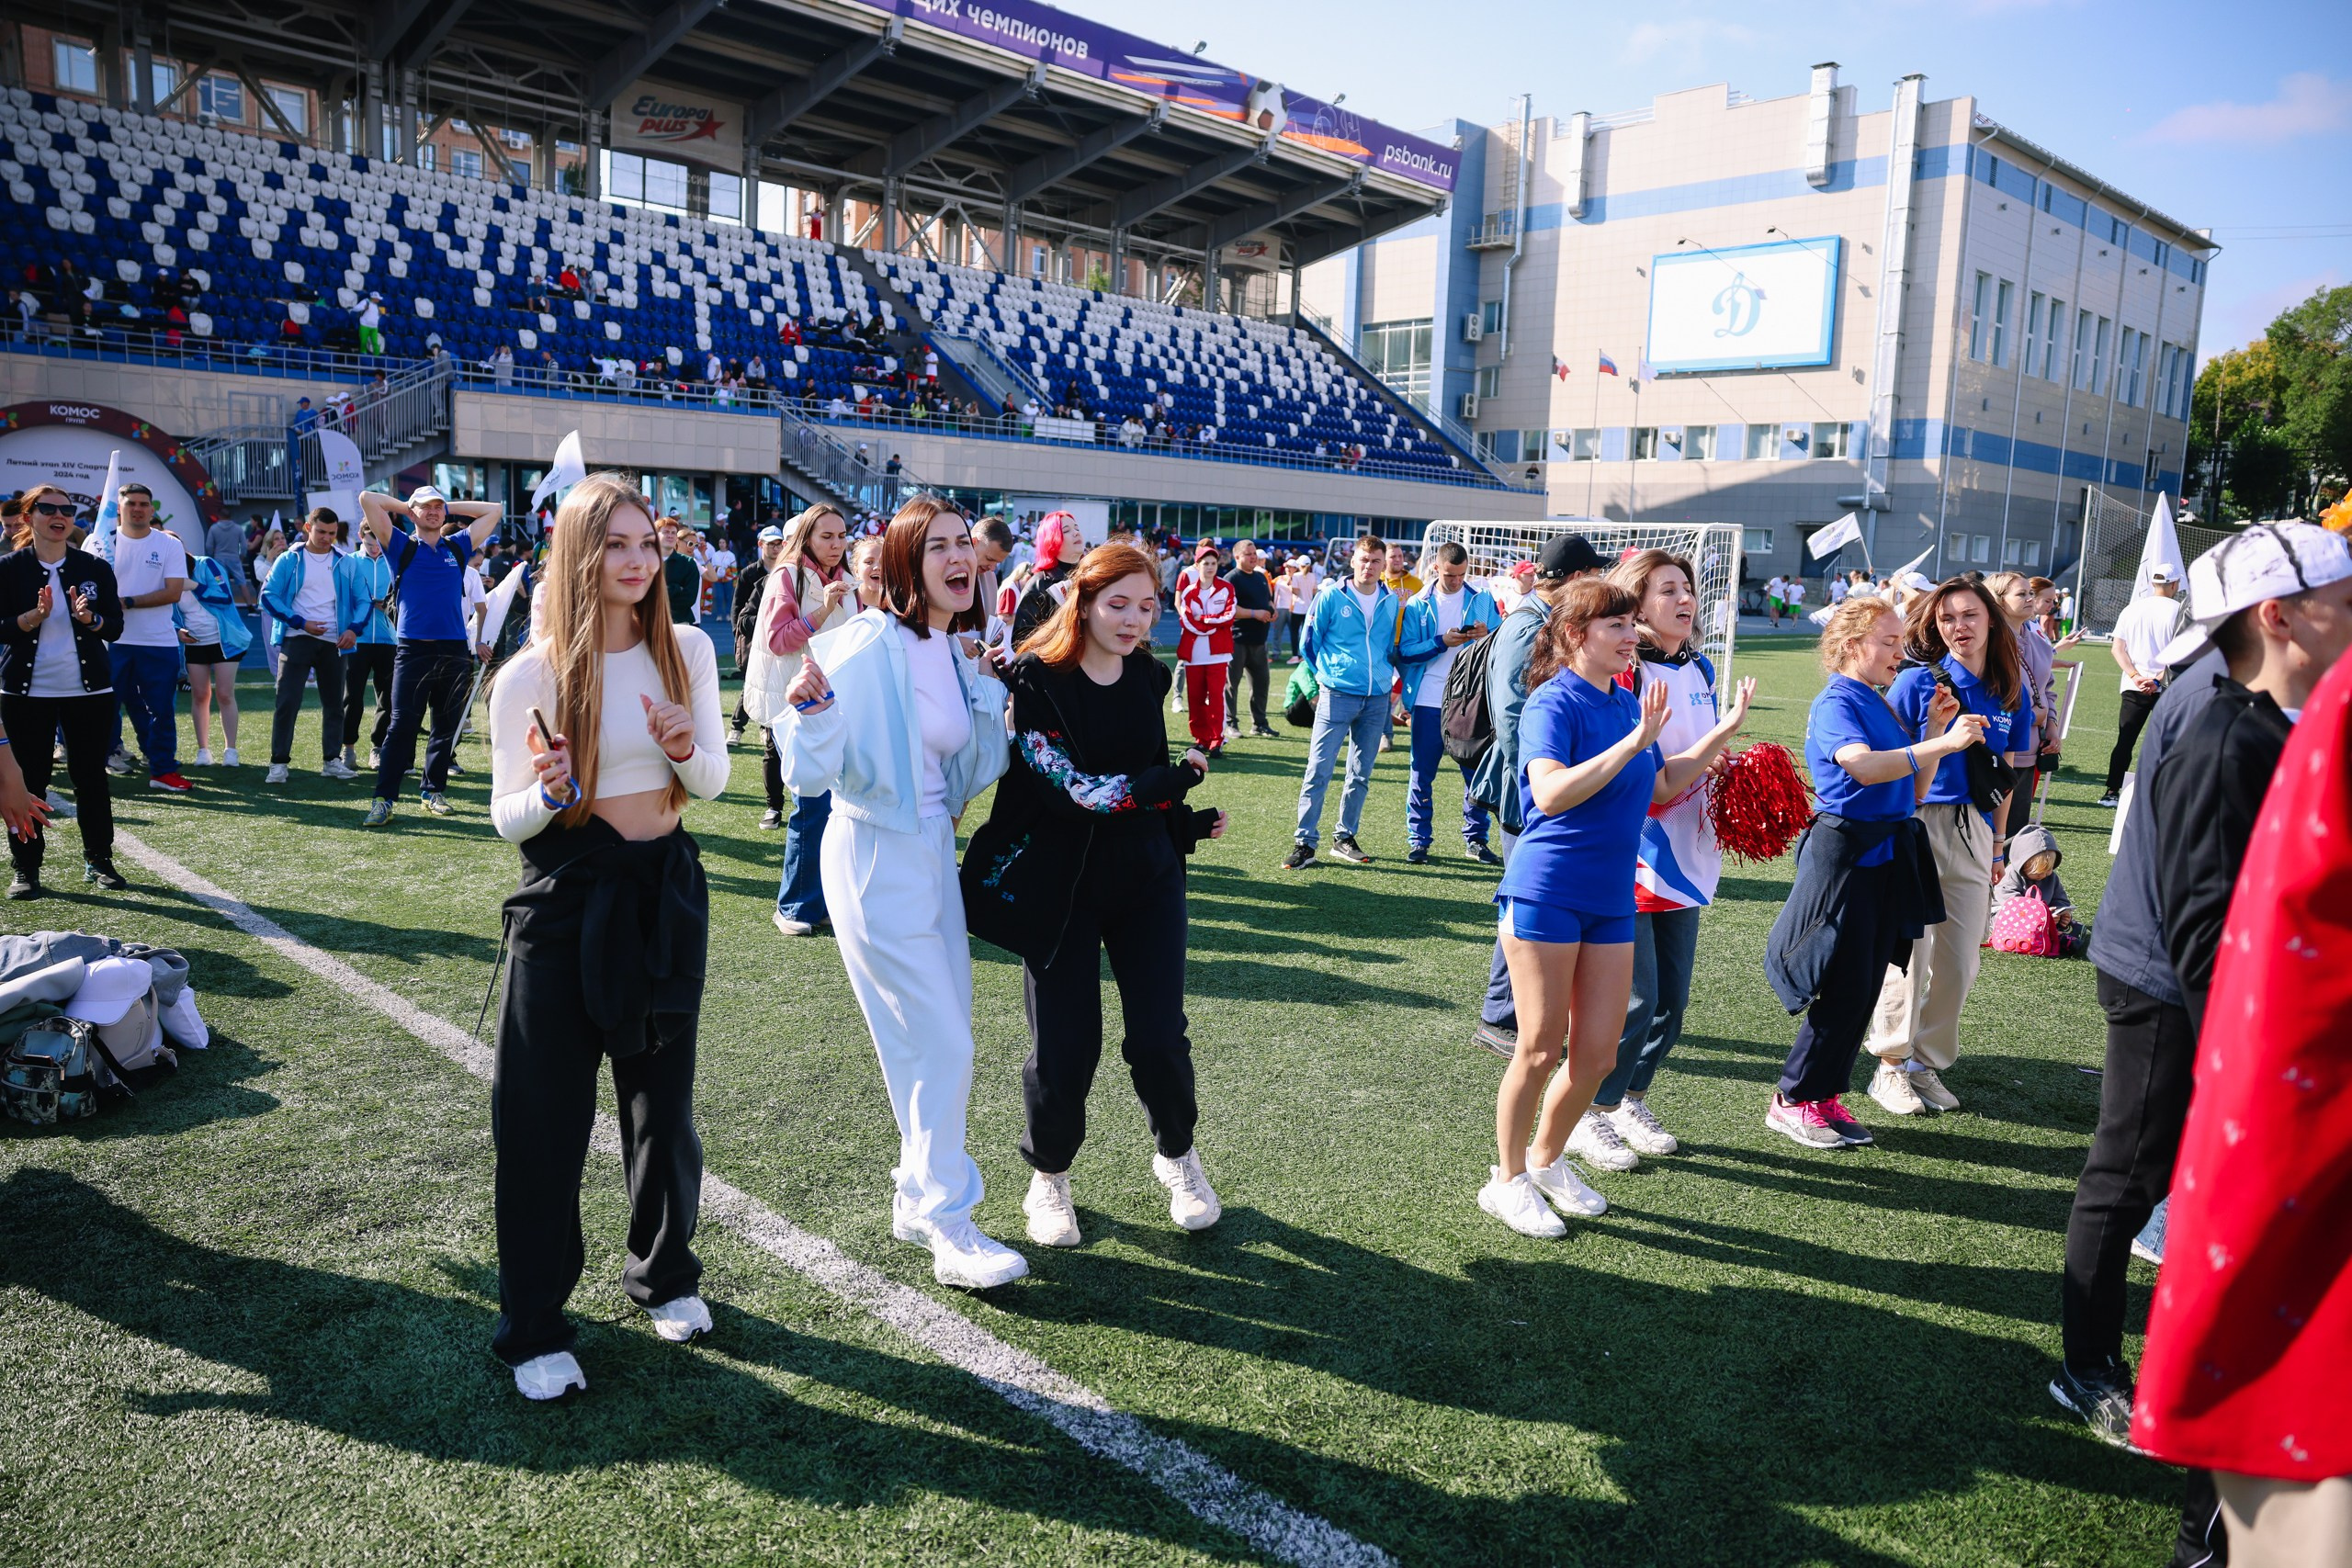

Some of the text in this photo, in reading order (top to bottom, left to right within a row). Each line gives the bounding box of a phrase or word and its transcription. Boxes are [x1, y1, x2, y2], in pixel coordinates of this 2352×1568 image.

[967, 4, 1089, 59] чемпионов
[1384, 144, 1453, 178] psbank.ru
[50, 404, 100, 419] КОМОС
[6, 458, 38, 467] Летний
[77, 463, 135, 472] Спартаады
